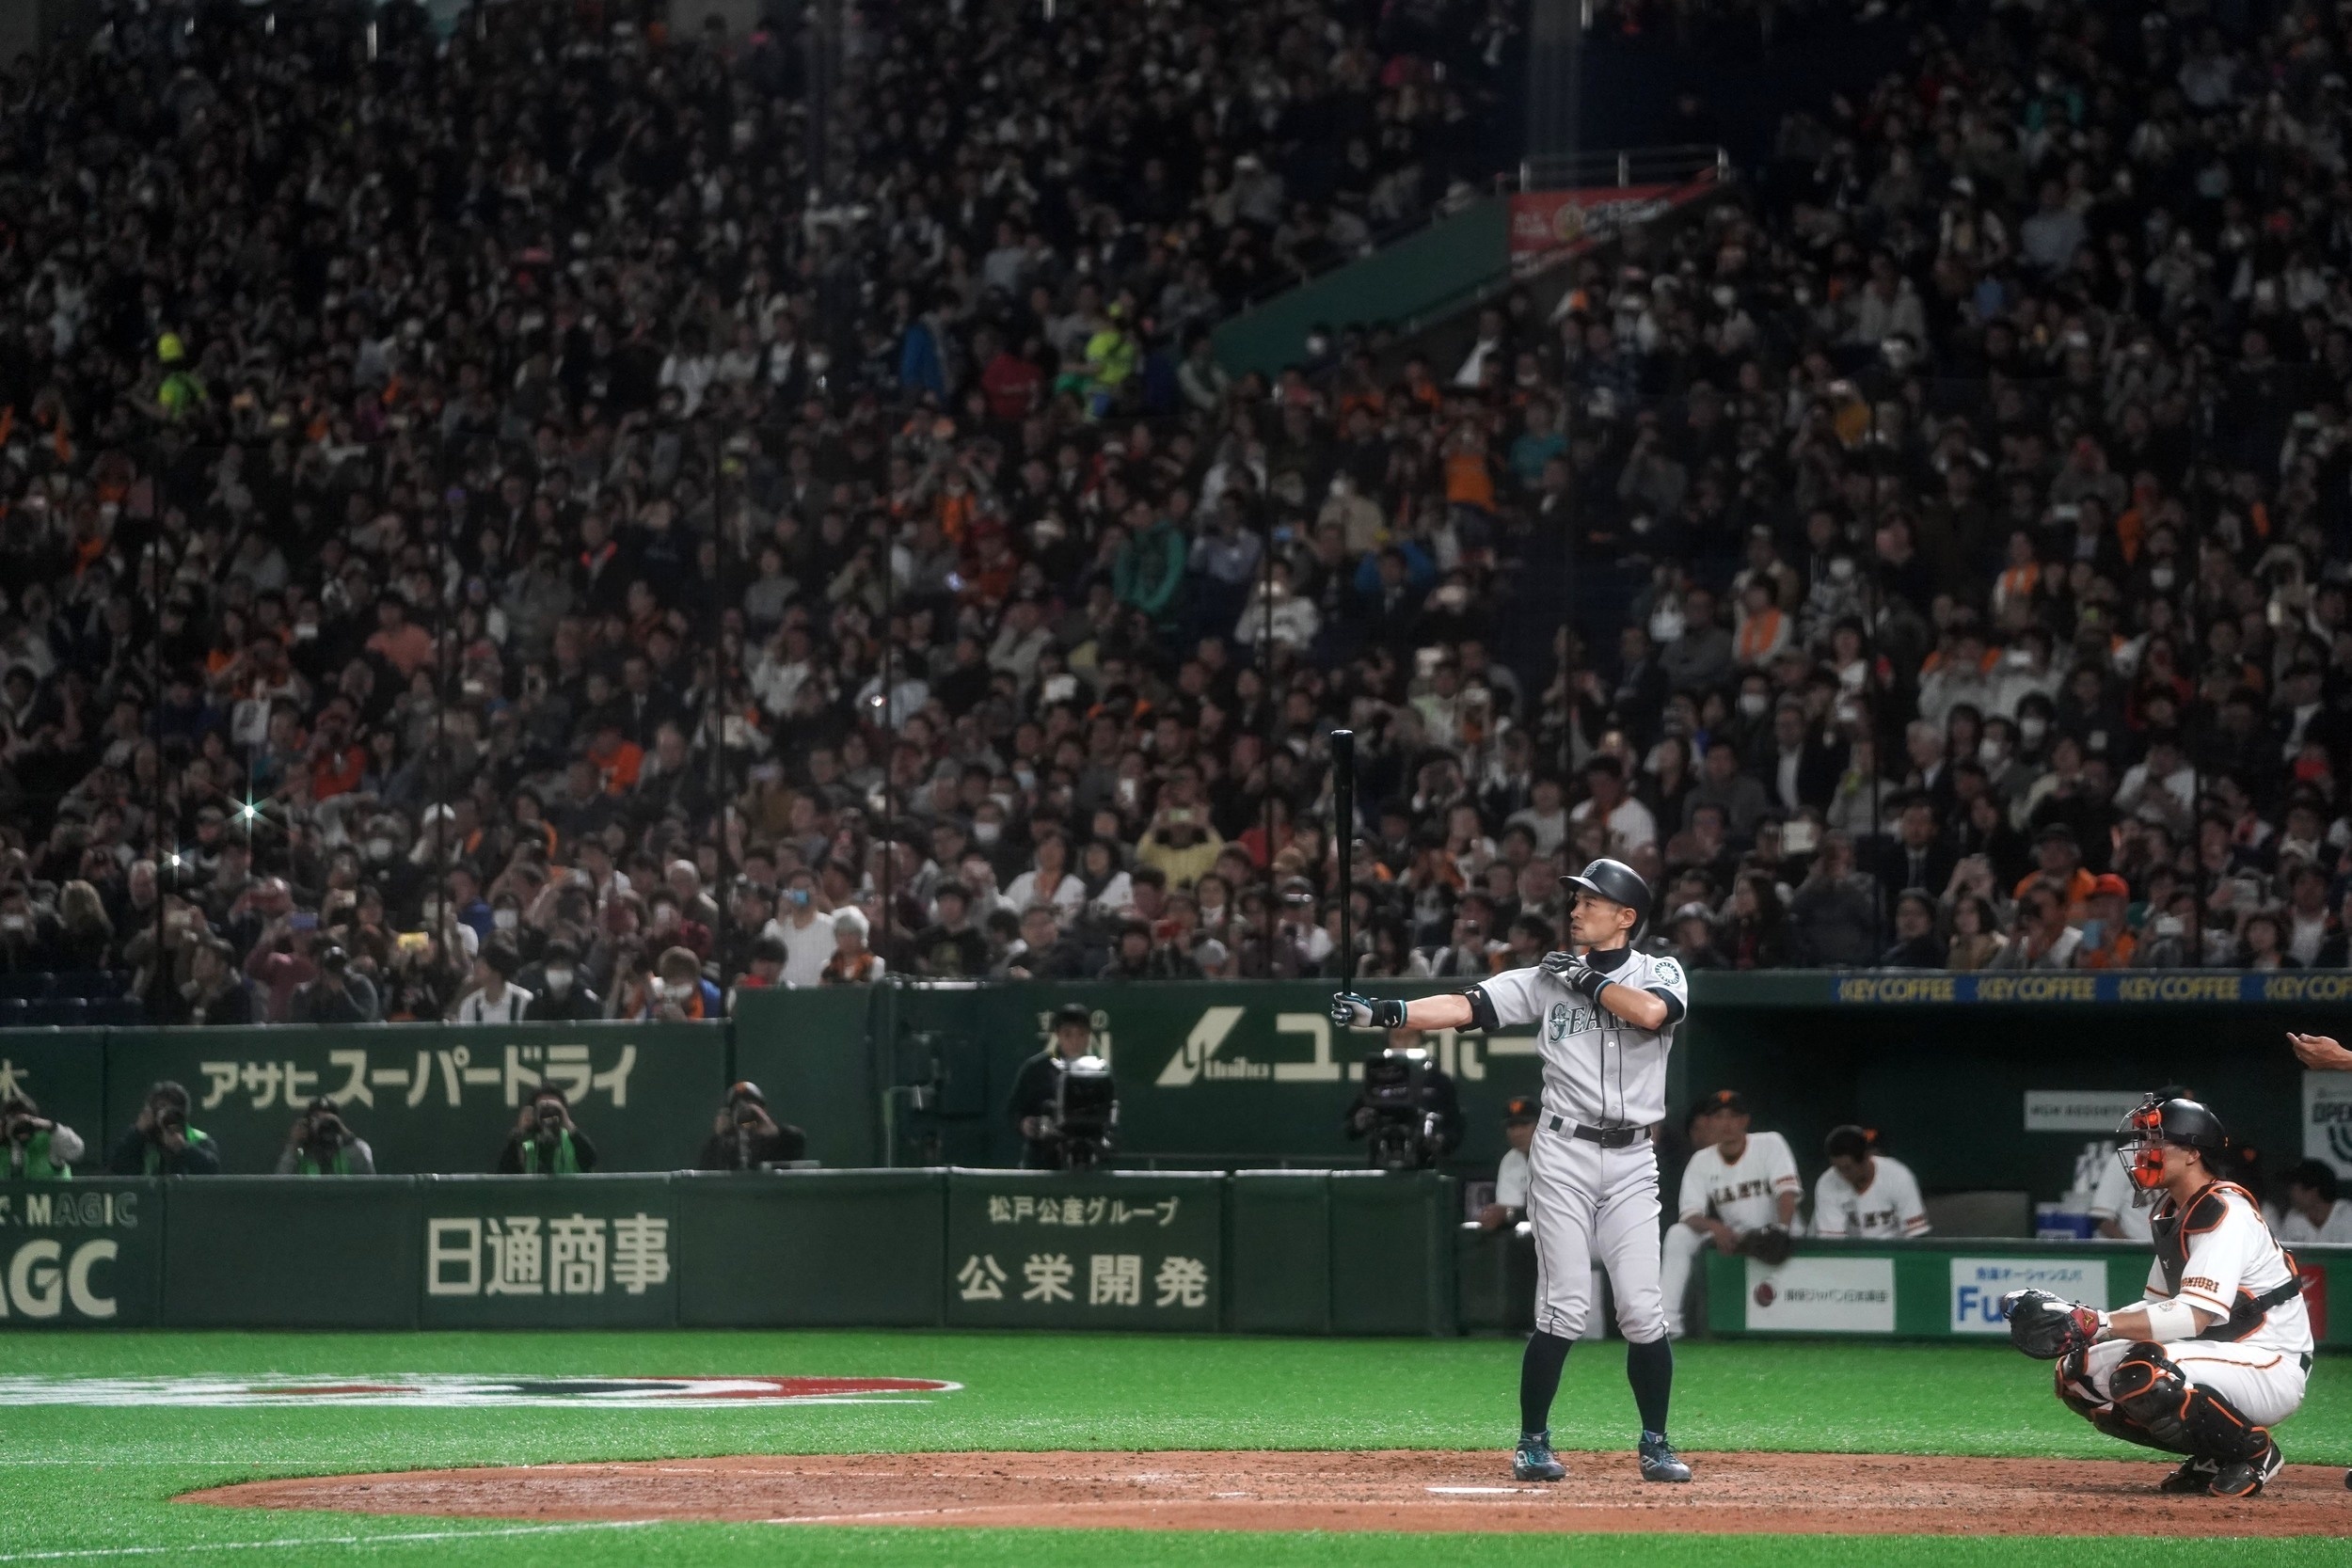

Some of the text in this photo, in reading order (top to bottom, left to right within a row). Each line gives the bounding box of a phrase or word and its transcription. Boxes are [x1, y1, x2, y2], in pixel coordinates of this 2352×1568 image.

[990, 1195, 1180, 1227] 松戸公産グループ
[428, 1212, 671, 1296] 日通商事
[957, 1253, 1208, 1307] 公栄開発
